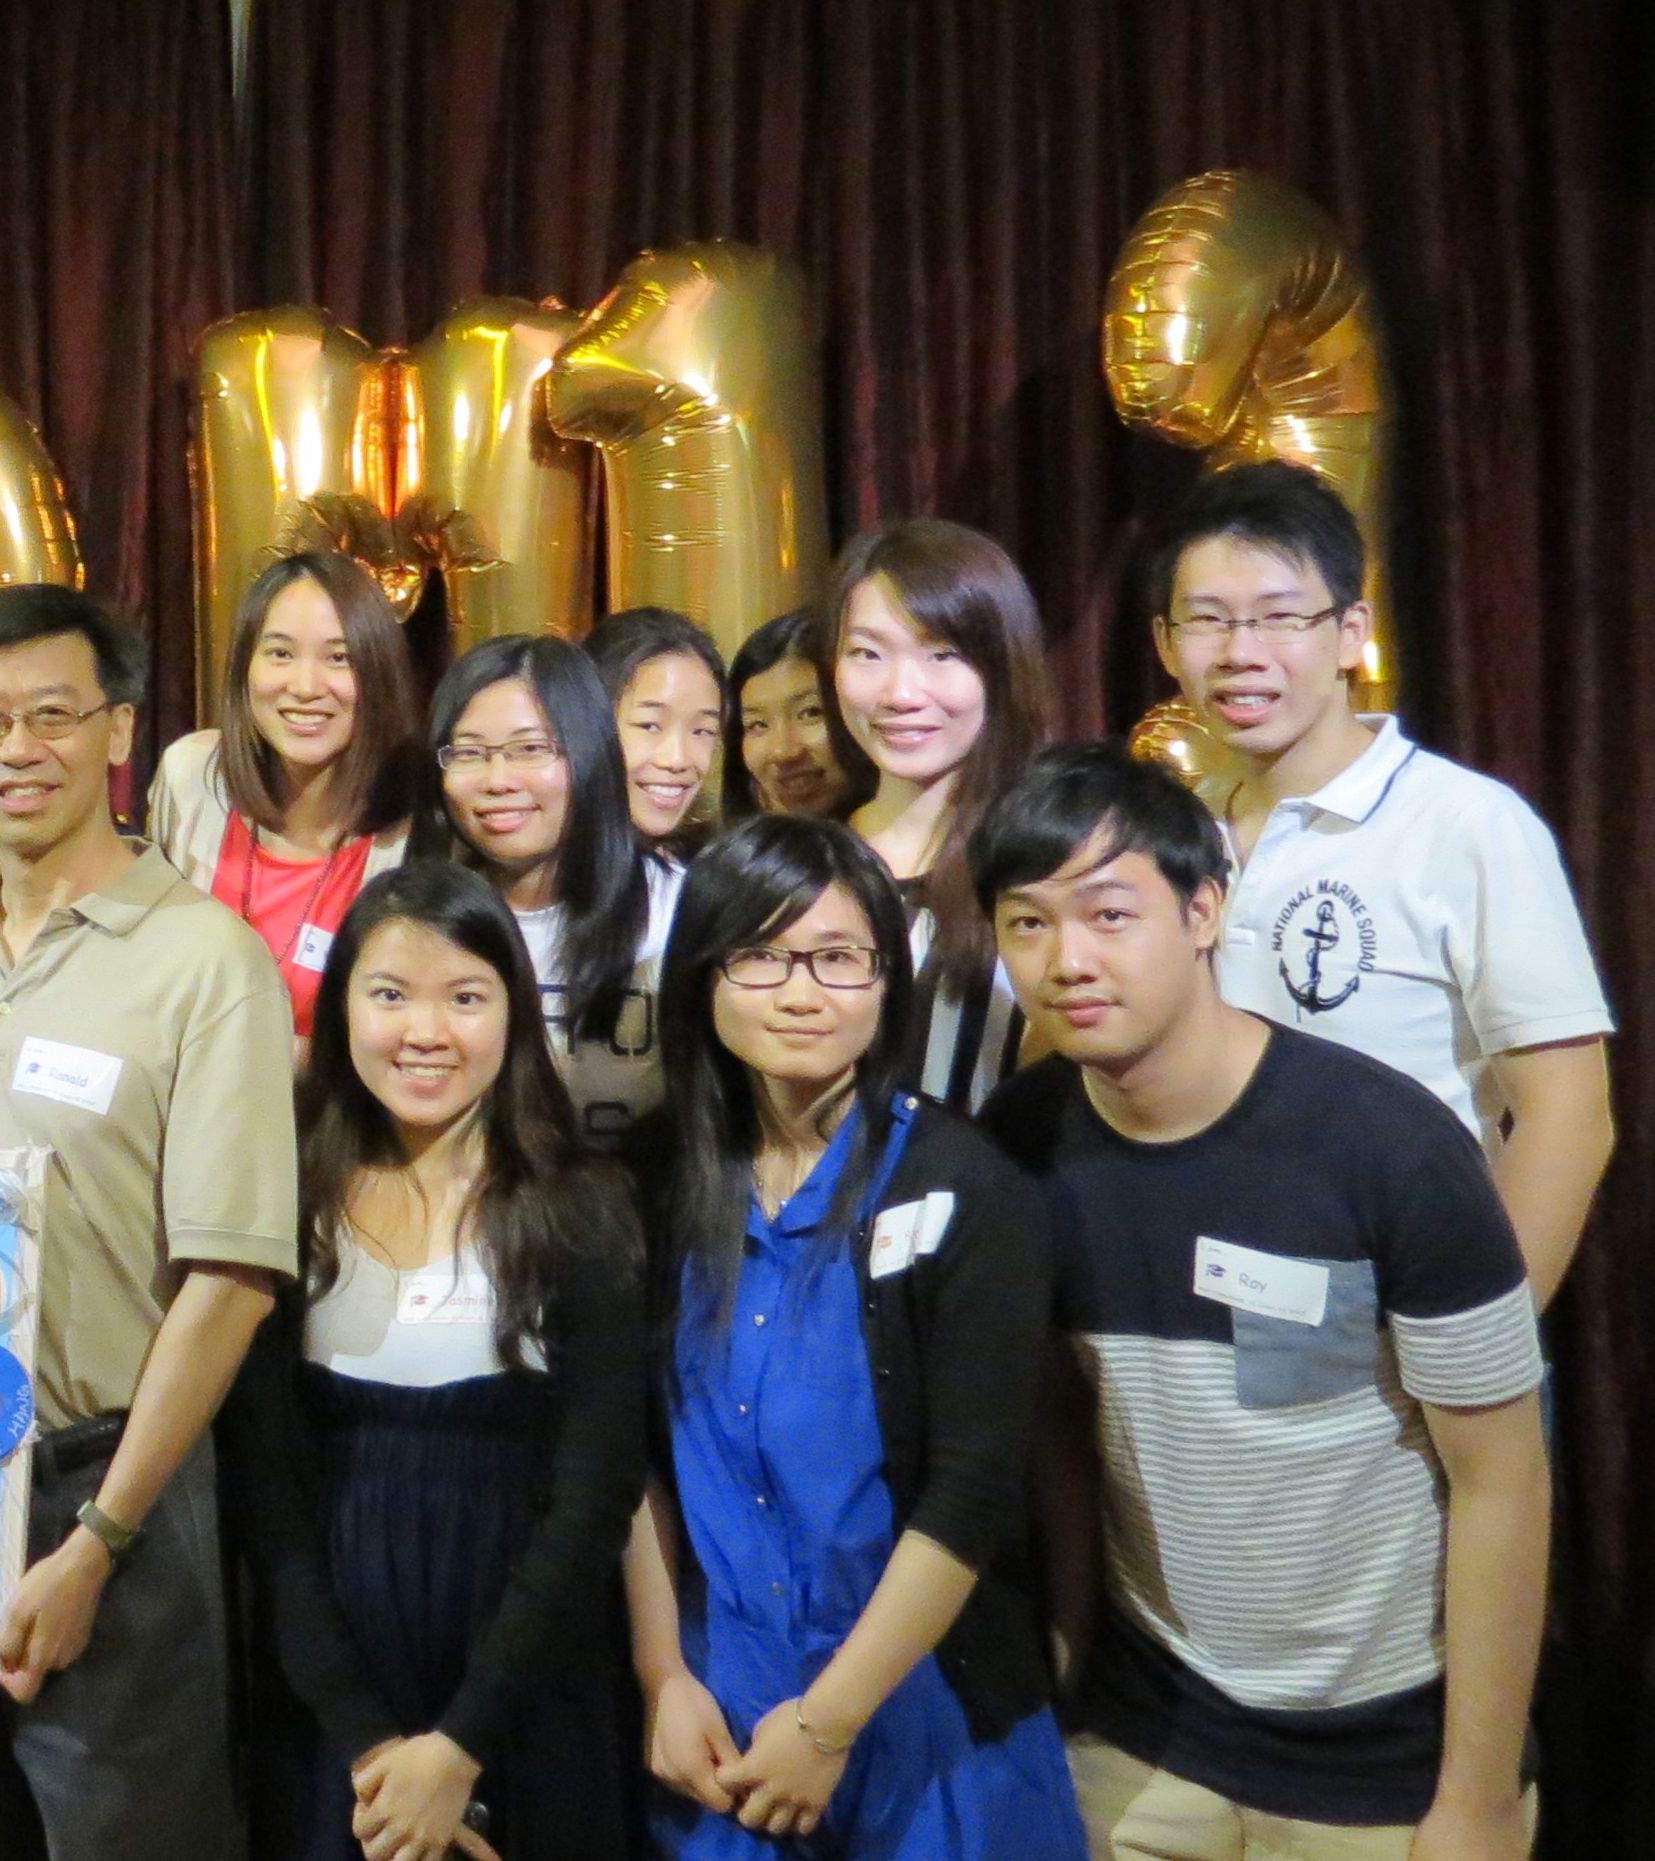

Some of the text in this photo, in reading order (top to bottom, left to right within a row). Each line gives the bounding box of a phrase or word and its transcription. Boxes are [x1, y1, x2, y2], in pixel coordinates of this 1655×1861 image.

[1272, 880, 1377, 972] NATIONAL MARINE SQUAD
[1238, 1273, 1268, 1293] Roy
